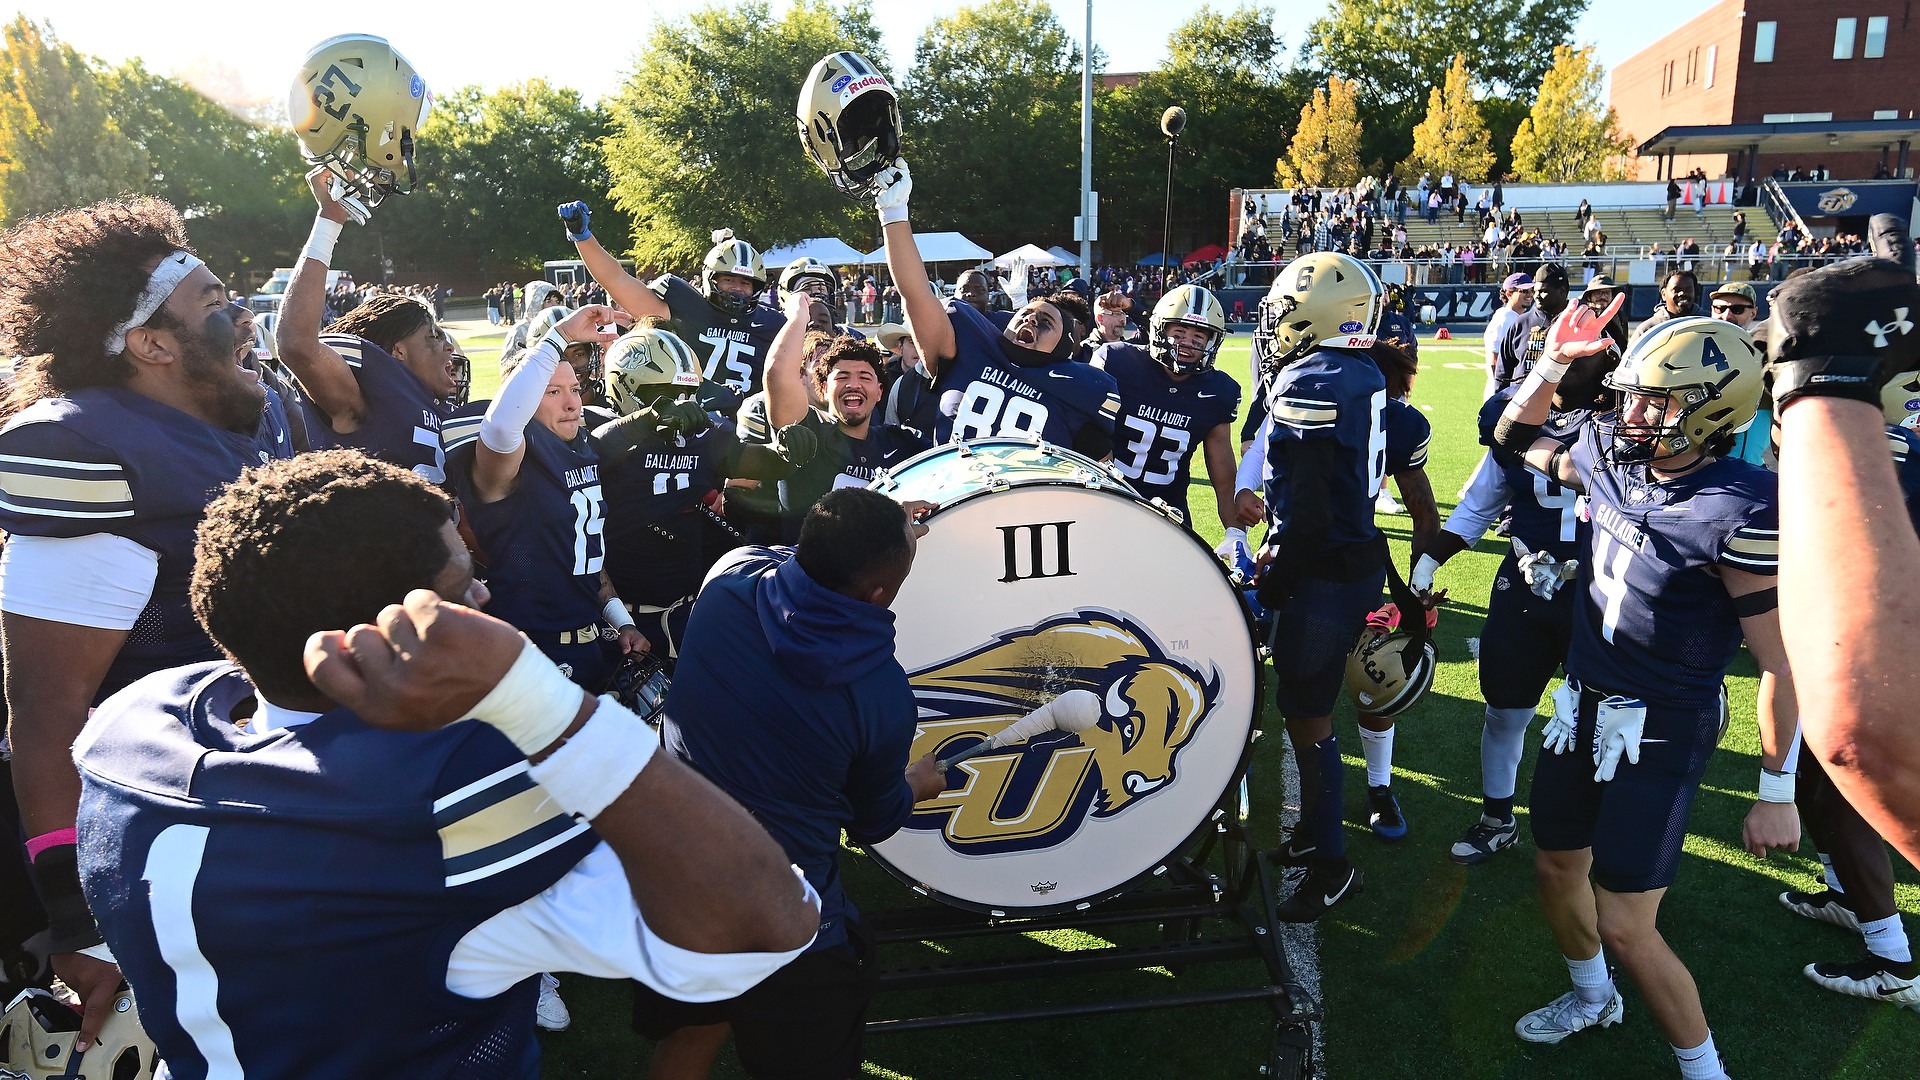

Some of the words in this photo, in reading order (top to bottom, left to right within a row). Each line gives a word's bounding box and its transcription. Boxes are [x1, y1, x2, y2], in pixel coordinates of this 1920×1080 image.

[311, 63, 363, 122] 27
[1296, 265, 1315, 292] 6
[706, 327, 750, 343] GALLAUDET
[1440, 330, 1449, 339] 30
[698, 332, 756, 393] 75
[1701, 336, 1730, 372] 4
[979, 366, 1043, 401] GALLAUDET
[1138, 404, 1191, 428] GALLAUDET
[644, 453, 699, 470] GALLAUDET
[1113, 414, 1191, 486] 33
[564, 464, 599, 488] GALLAUDET
[845, 464, 879, 481] GALLA
[569, 484, 605, 575] 15
[1595, 503, 1650, 554] GALLAUDET
[995, 520, 1078, 583] III
[1592, 528, 1634, 646] 4
[1170, 639, 1189, 650] TM
[141, 823, 245, 1080] 1
